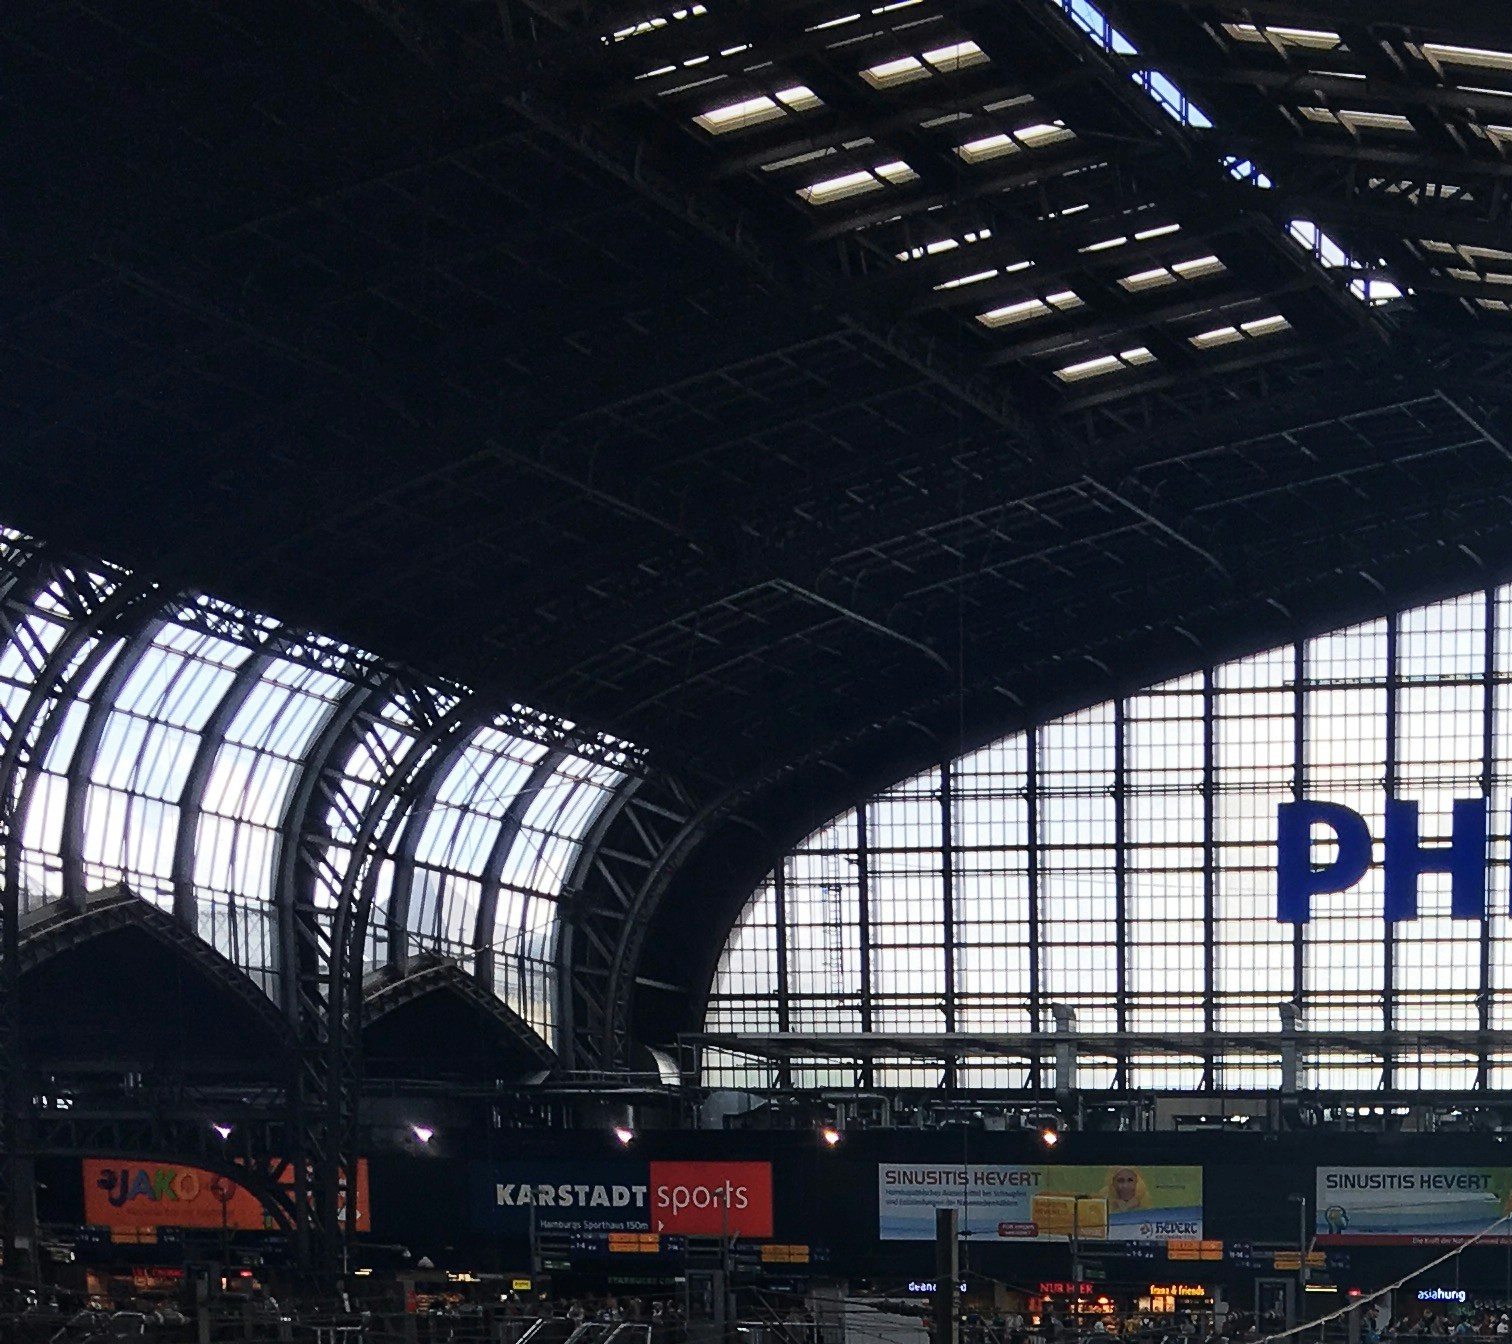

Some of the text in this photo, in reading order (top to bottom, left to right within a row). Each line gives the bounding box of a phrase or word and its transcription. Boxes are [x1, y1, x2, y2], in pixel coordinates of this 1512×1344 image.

[885, 1170, 1042, 1186] SINUSITIS HEVERT
[1326, 1174, 1492, 1190] SINUSITIS HEVERT
[496, 1183, 647, 1208] KARSTADT
[657, 1180, 749, 1215] sports
[1179, 1284, 1205, 1296] friends
